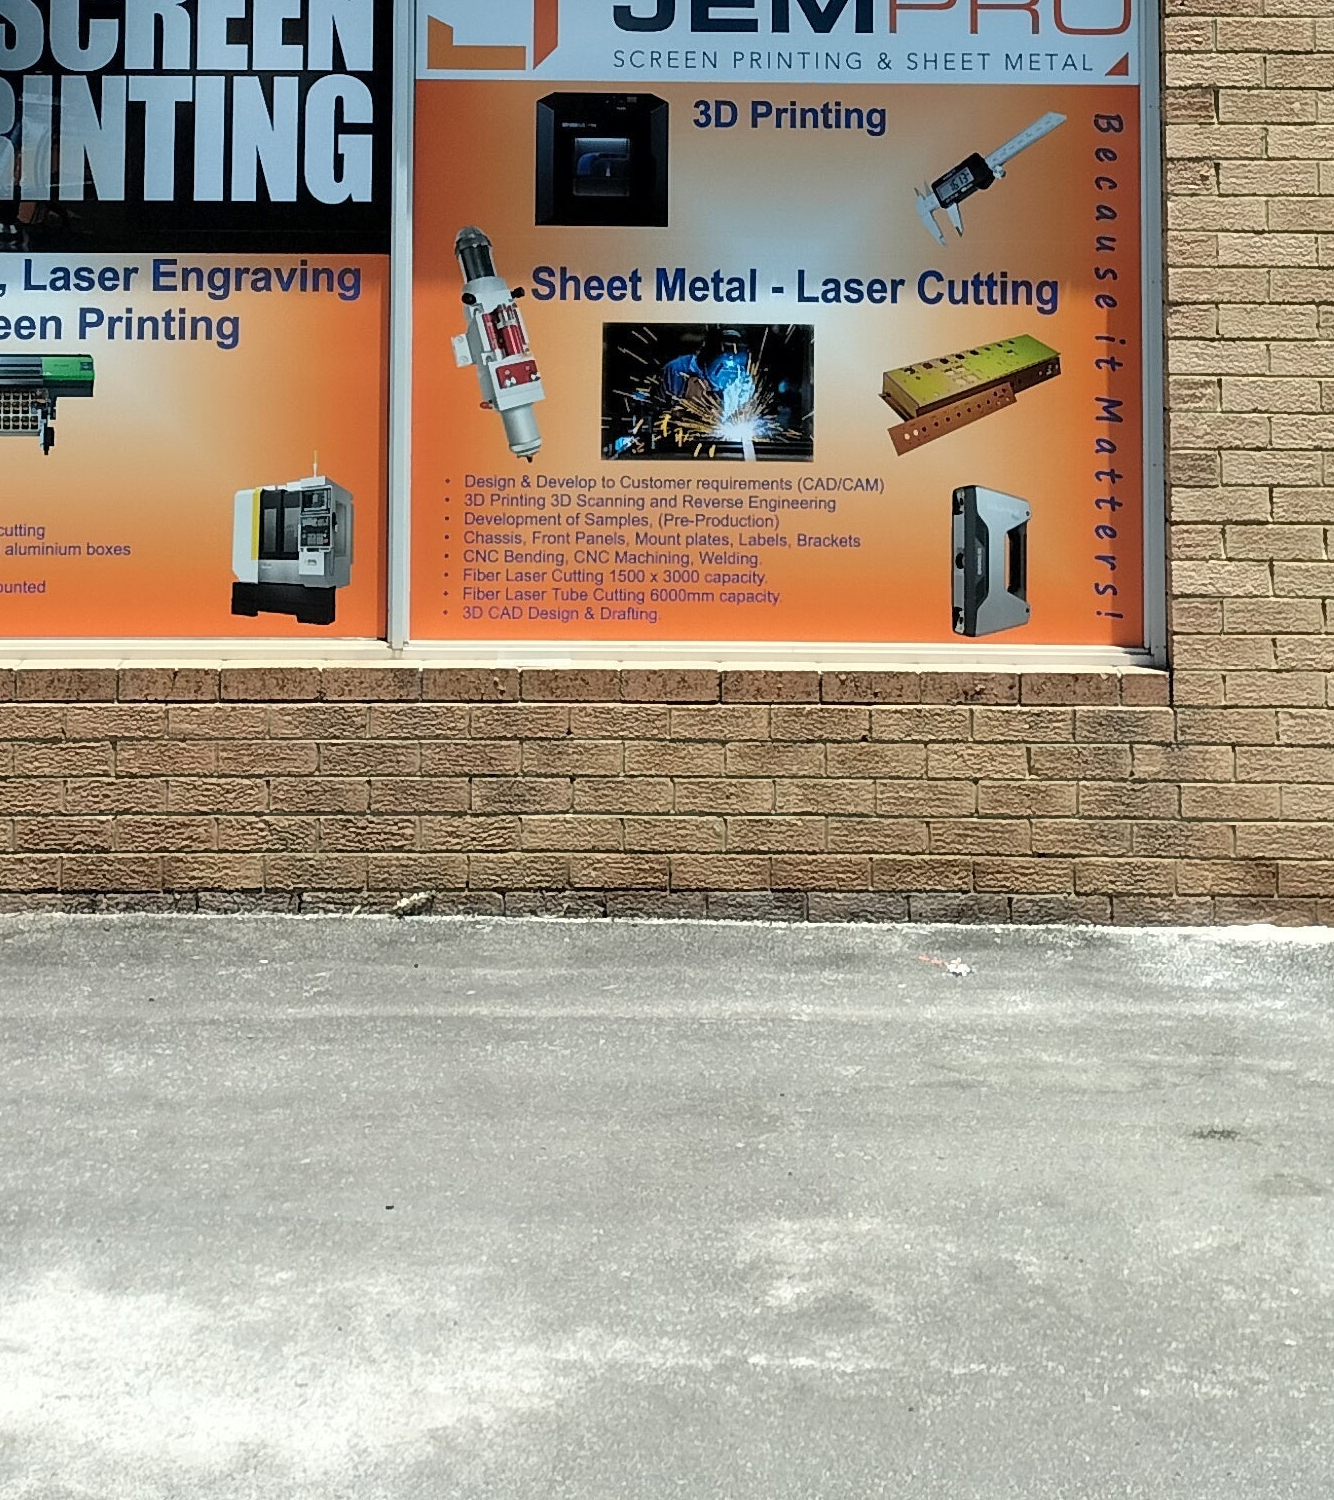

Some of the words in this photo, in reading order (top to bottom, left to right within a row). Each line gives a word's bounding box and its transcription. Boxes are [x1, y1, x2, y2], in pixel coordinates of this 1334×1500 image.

[614, 50, 717, 69] SCREEN
[734, 51, 861, 69] PRINTING
[878, 52, 892, 71] &
[907, 52, 990, 71] SHEET
[1005, 53, 1093, 71] METAL
[693, 100, 738, 128] 3D
[751, 101, 886, 136] Printing
[1093, 113, 1124, 309] Because
[23, 258, 139, 292] Laser
[152, 258, 362, 301] Engraving
[532, 266, 642, 301] Sheet
[656, 267, 757, 303] Metal
[798, 269, 906, 304] Laser
[918, 270, 1058, 315] Cutting
[79, 307, 239, 349] Printing
[1094, 334, 1127, 373] it
[465, 475, 515, 492] Design
[521, 474, 531, 488] &
[537, 474, 596, 492] Develop
[602, 476, 615, 489] to
[620, 475, 692, 490] Customer
[697, 476, 792, 493] requirements
[798, 477, 884, 494] (CAD/CAM)
[464, 493, 484, 507] 3D
[491, 493, 545, 510] Printing
[551, 493, 571, 507] 3D
[577, 494, 645, 511] Scanning
[650, 494, 677, 509] and
[683, 494, 743, 508] Reverse
[749, 495, 836, 513] Engineering
[1094, 396, 1125, 620] Matters!
[465, 512, 561, 529] Development
[566, 513, 581, 527] of
[585, 513, 652, 530] Samples,
[659, 514, 779, 531] (Pre-Production)
[5, 542, 81, 555] aluminium
[87, 542, 131, 555] boxes
[464, 531, 526, 546] Chassis,
[533, 531, 570, 545] Front
[576, 532, 629, 548] Panels,
[636, 532, 681, 546] Mount
[686, 532, 733, 549] plates,
[739, 532, 791, 549] Labels,
[797, 534, 861, 548] Brackets
[463, 549, 498, 563] CNC
[505, 549, 568, 567] Bending,
[574, 549, 609, 564] CNC
[615, 550, 693, 568] Machining,
[464, 568, 501, 582] Fiber
[506, 568, 547, 583] Laser
[552, 568, 603, 586] Cutting
[610, 570, 645, 583] 1500
[650, 572, 658, 583] x
[663, 569, 699, 584] 3000
[463, 587, 501, 601] Fiber
[506, 587, 547, 601] Laser
[552, 587, 588, 601] Tube
[593, 587, 645, 605] Cutting
[651, 588, 714, 603] 6000mm
[463, 606, 483, 619] 3D
[488, 606, 523, 619] CAD
[529, 606, 578, 623] Design
[585, 607, 595, 619] &
